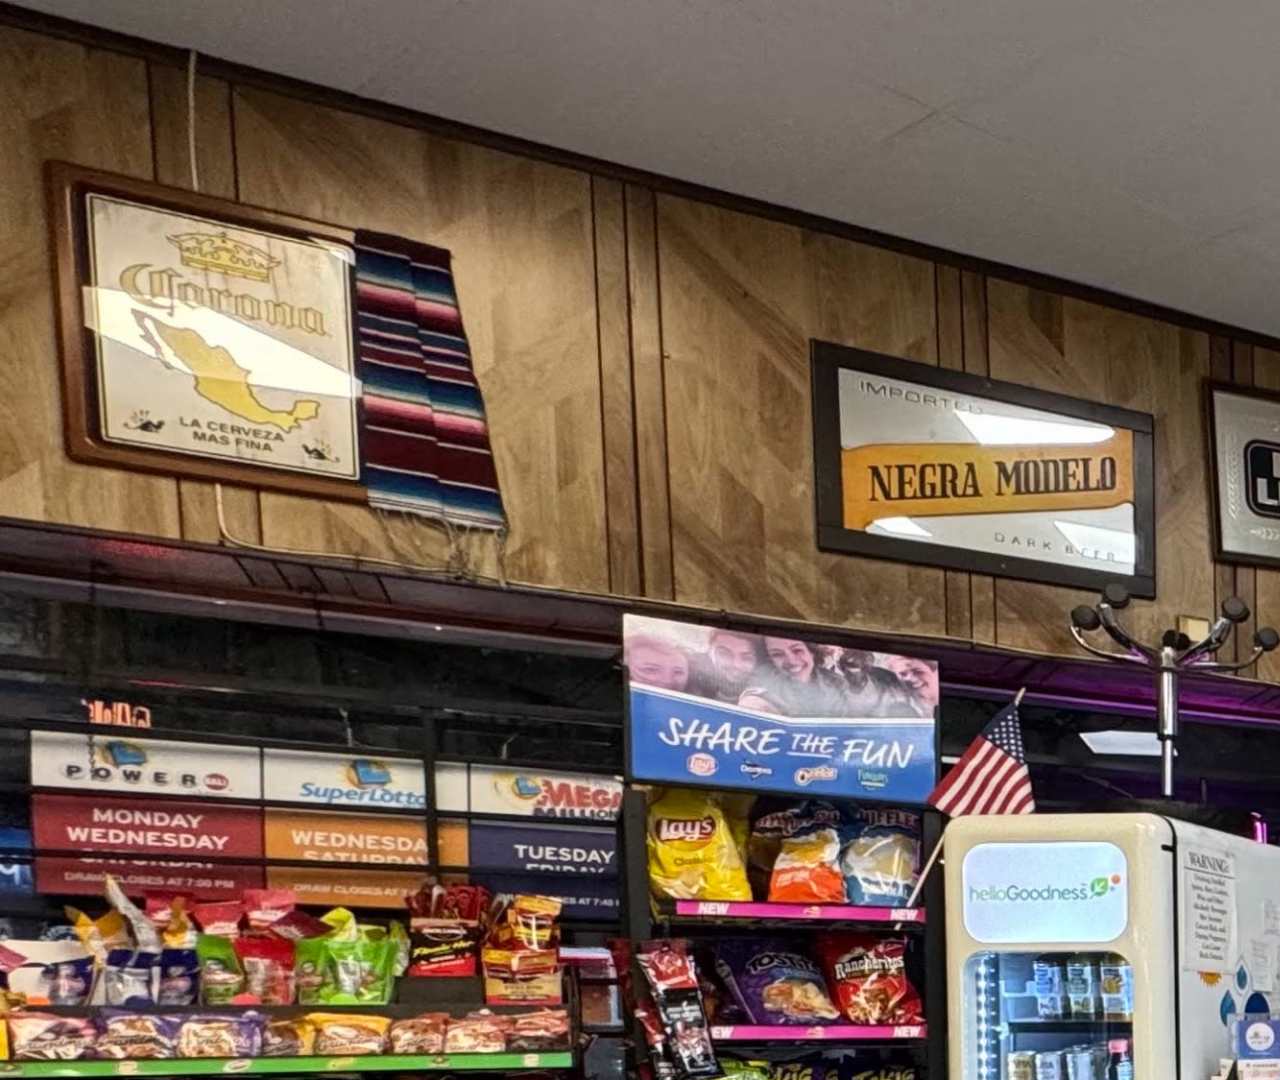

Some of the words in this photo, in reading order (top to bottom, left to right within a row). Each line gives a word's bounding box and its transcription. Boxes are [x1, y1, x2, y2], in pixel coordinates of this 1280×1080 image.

[118, 263, 329, 337] Corona
[859, 379, 985, 416] IMPORTED
[179, 416, 201, 431] LA
[205, 420, 287, 444] CERVEZA
[192, 429, 230, 447] MAS
[234, 436, 274, 453] FINA
[869, 460, 982, 502] NEGRA
[995, 456, 1117, 496] MODELO
[994, 531, 1054, 552] DARK
[658, 717, 786, 756] SHARE
[789, 732, 837, 754] THE
[840, 738, 915, 769] FUN
[65, 764, 197, 788] POWER
[92, 808, 204, 829] MONDAY
[66, 826, 229, 851] WEDNESDAY
[291, 830, 430, 851] WEDNESDA
[513, 844, 616, 865] TUESDAY
[968, 885, 1089, 903] helloGoodness
[698, 903, 729, 915] NEW
[891, 908, 918, 921] NEW
[894, 1026, 921, 1038] NEW
